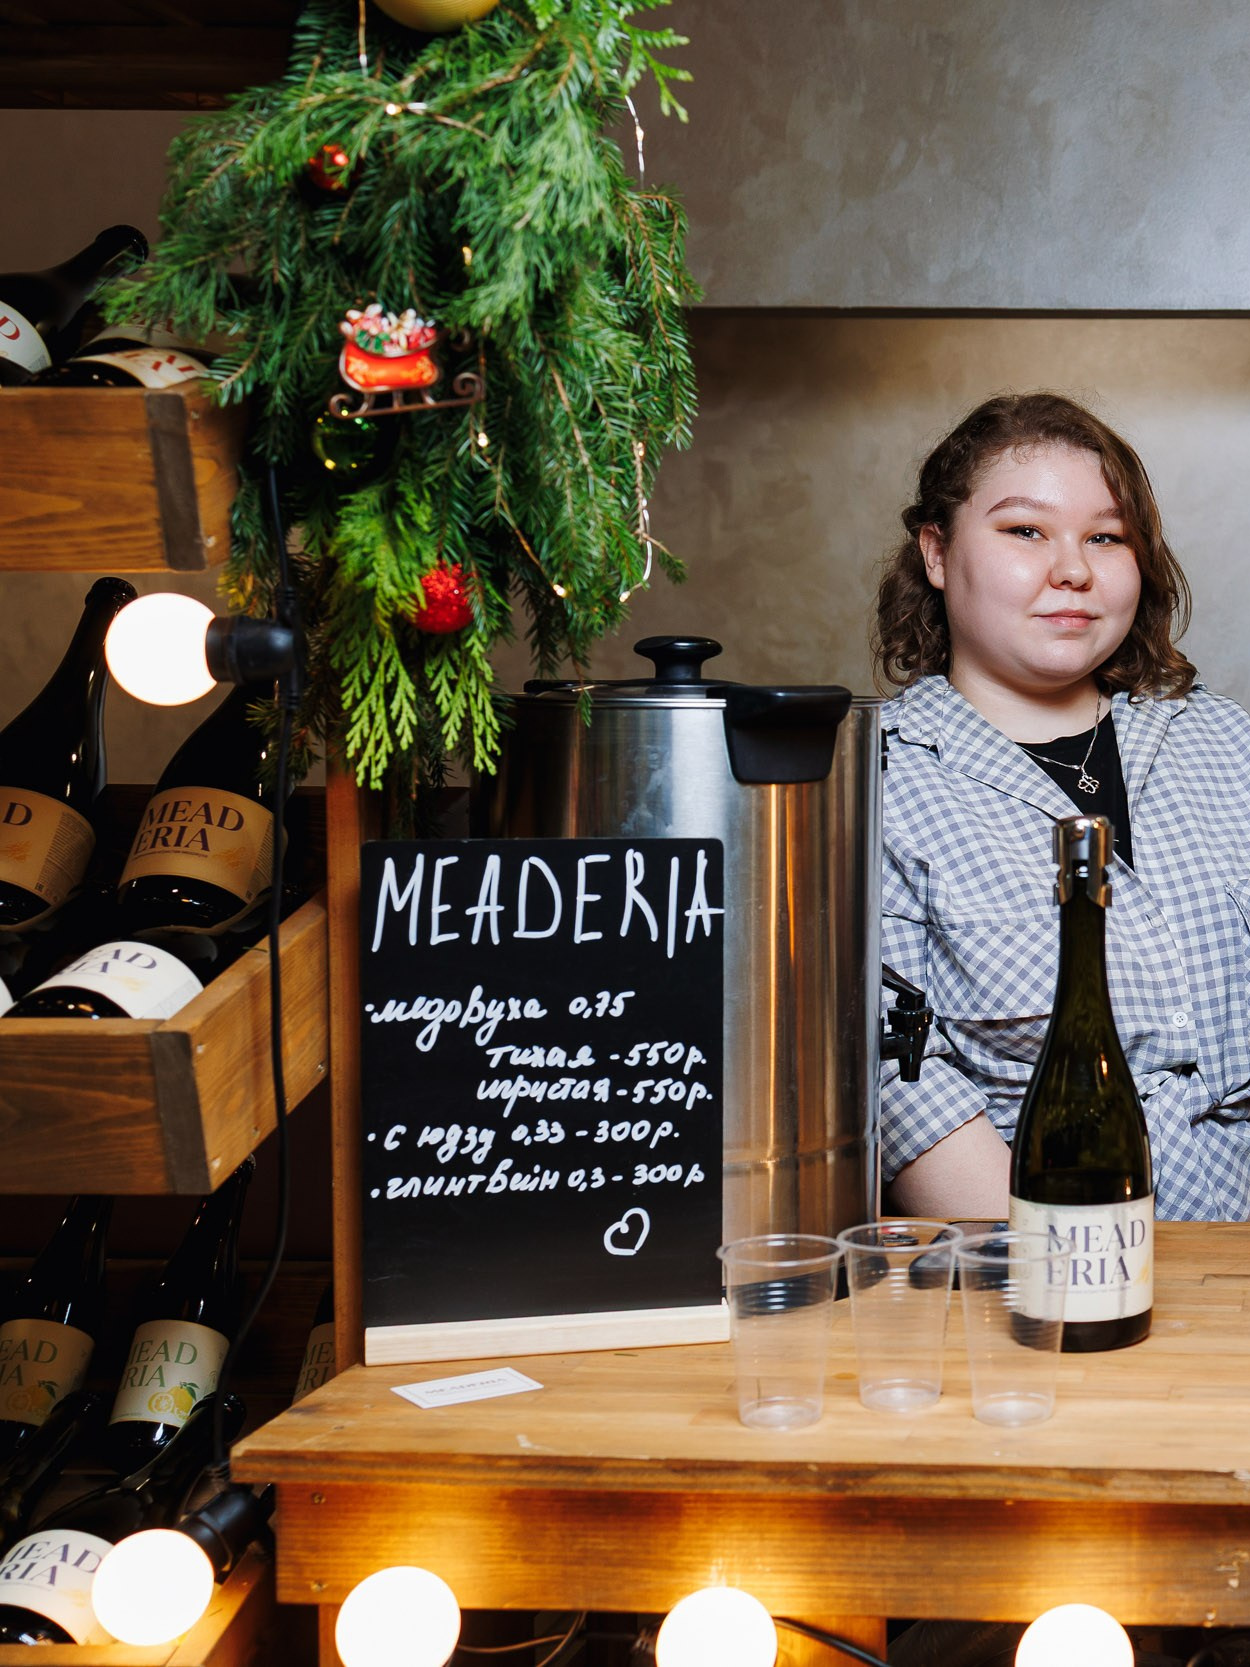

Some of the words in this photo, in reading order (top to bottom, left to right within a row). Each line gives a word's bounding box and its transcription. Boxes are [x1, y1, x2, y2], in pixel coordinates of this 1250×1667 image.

[141, 800, 244, 832] MEAD
[134, 825, 210, 855] ERIA
[371, 849, 725, 958] MEADERIA
[370, 985, 547, 1051] медовуха
[568, 991, 635, 1018] 0,75
[486, 1045, 595, 1068] тихая
[476, 1074, 610, 1118] игристая
[417, 1123, 496, 1164] юдзу
[511, 1119, 566, 1146] 0,33
[386, 1158, 560, 1200] глинтвейн
[567, 1166, 606, 1192] 0,3
[1047, 1219, 1146, 1253] MEAD
[1047, 1255, 1131, 1287] ERIA
